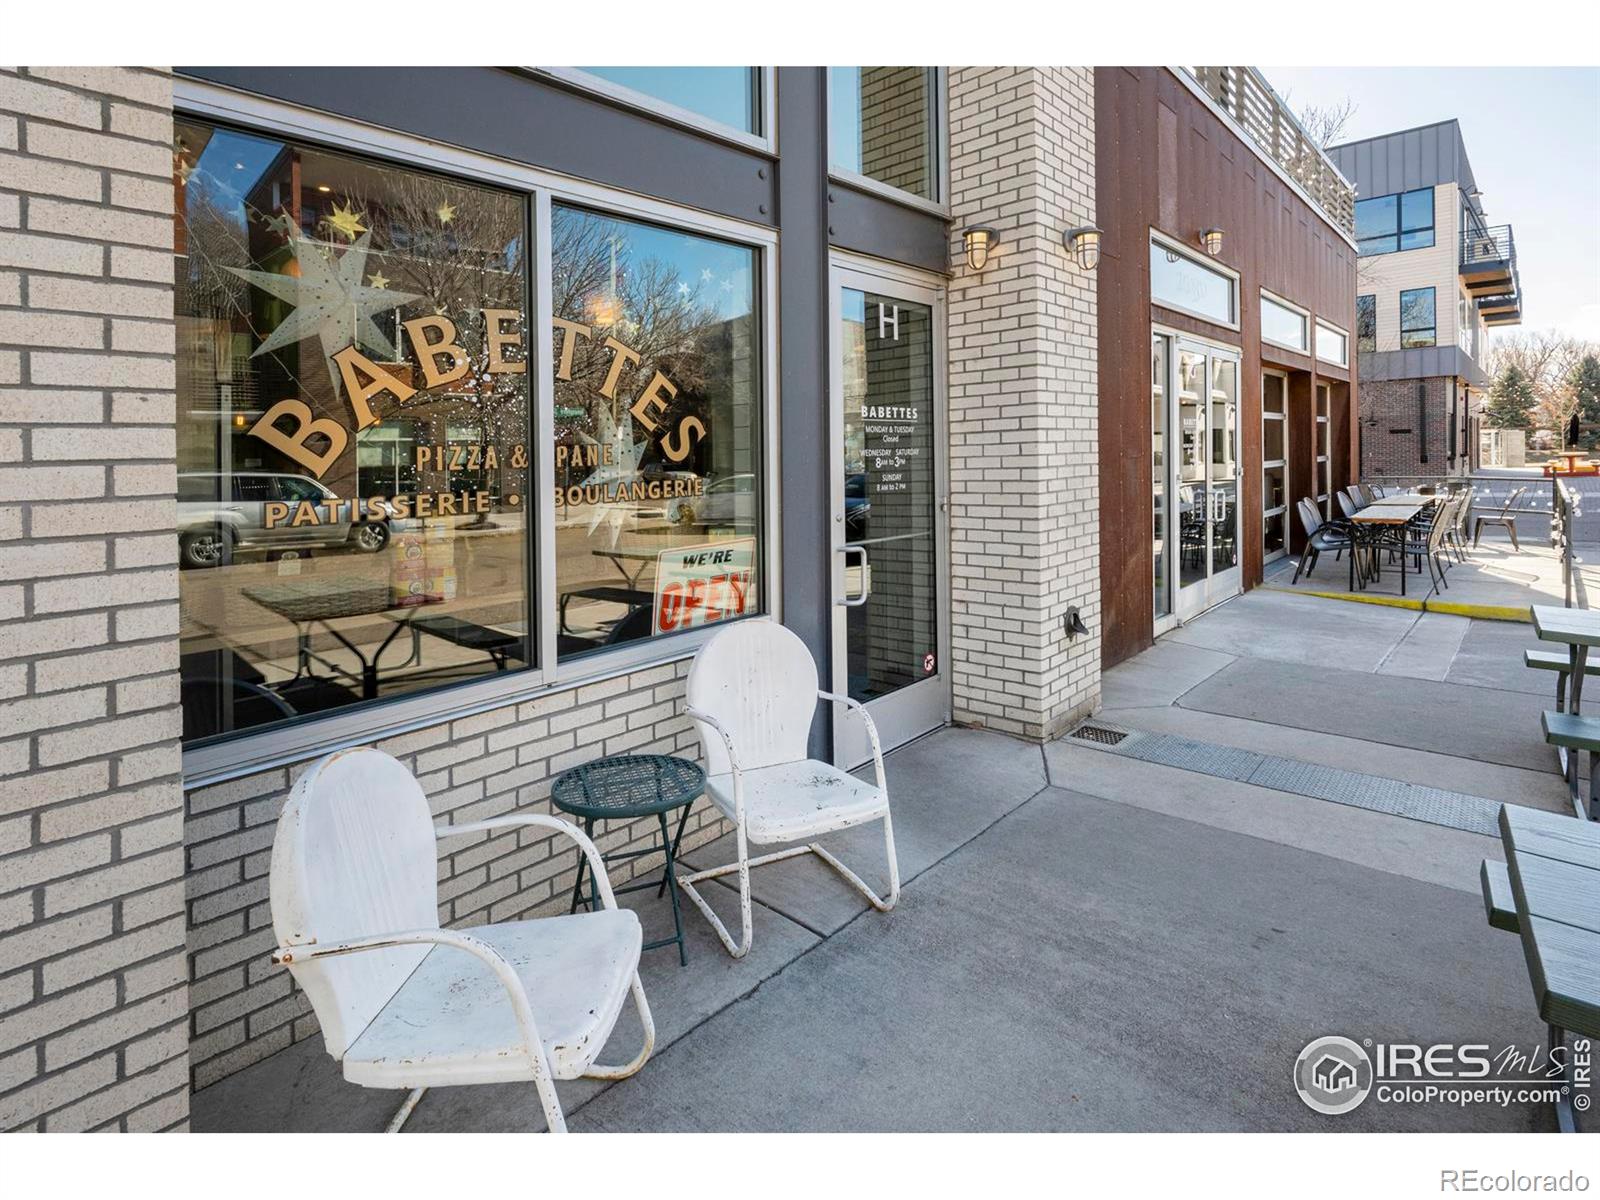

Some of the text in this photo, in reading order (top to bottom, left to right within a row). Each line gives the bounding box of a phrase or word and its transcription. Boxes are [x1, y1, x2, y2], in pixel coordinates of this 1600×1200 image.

[879, 303, 898, 340] H
[247, 307, 707, 480] BABETTES
[861, 406, 918, 419] BABETTES
[865, 425, 889, 433] MONDAY
[894, 425, 915, 433] TUESDAY
[416, 443, 613, 471] PIZZA & PANE
[860, 448, 920, 457] WEDNESDAY SATURDAY
[882, 473, 902, 482] SUNDAY
[264, 478, 704, 528] PATISSERIE BOULANGERIE
[682, 549, 734, 568] WE'RE
[659, 569, 751, 632] OPEN
